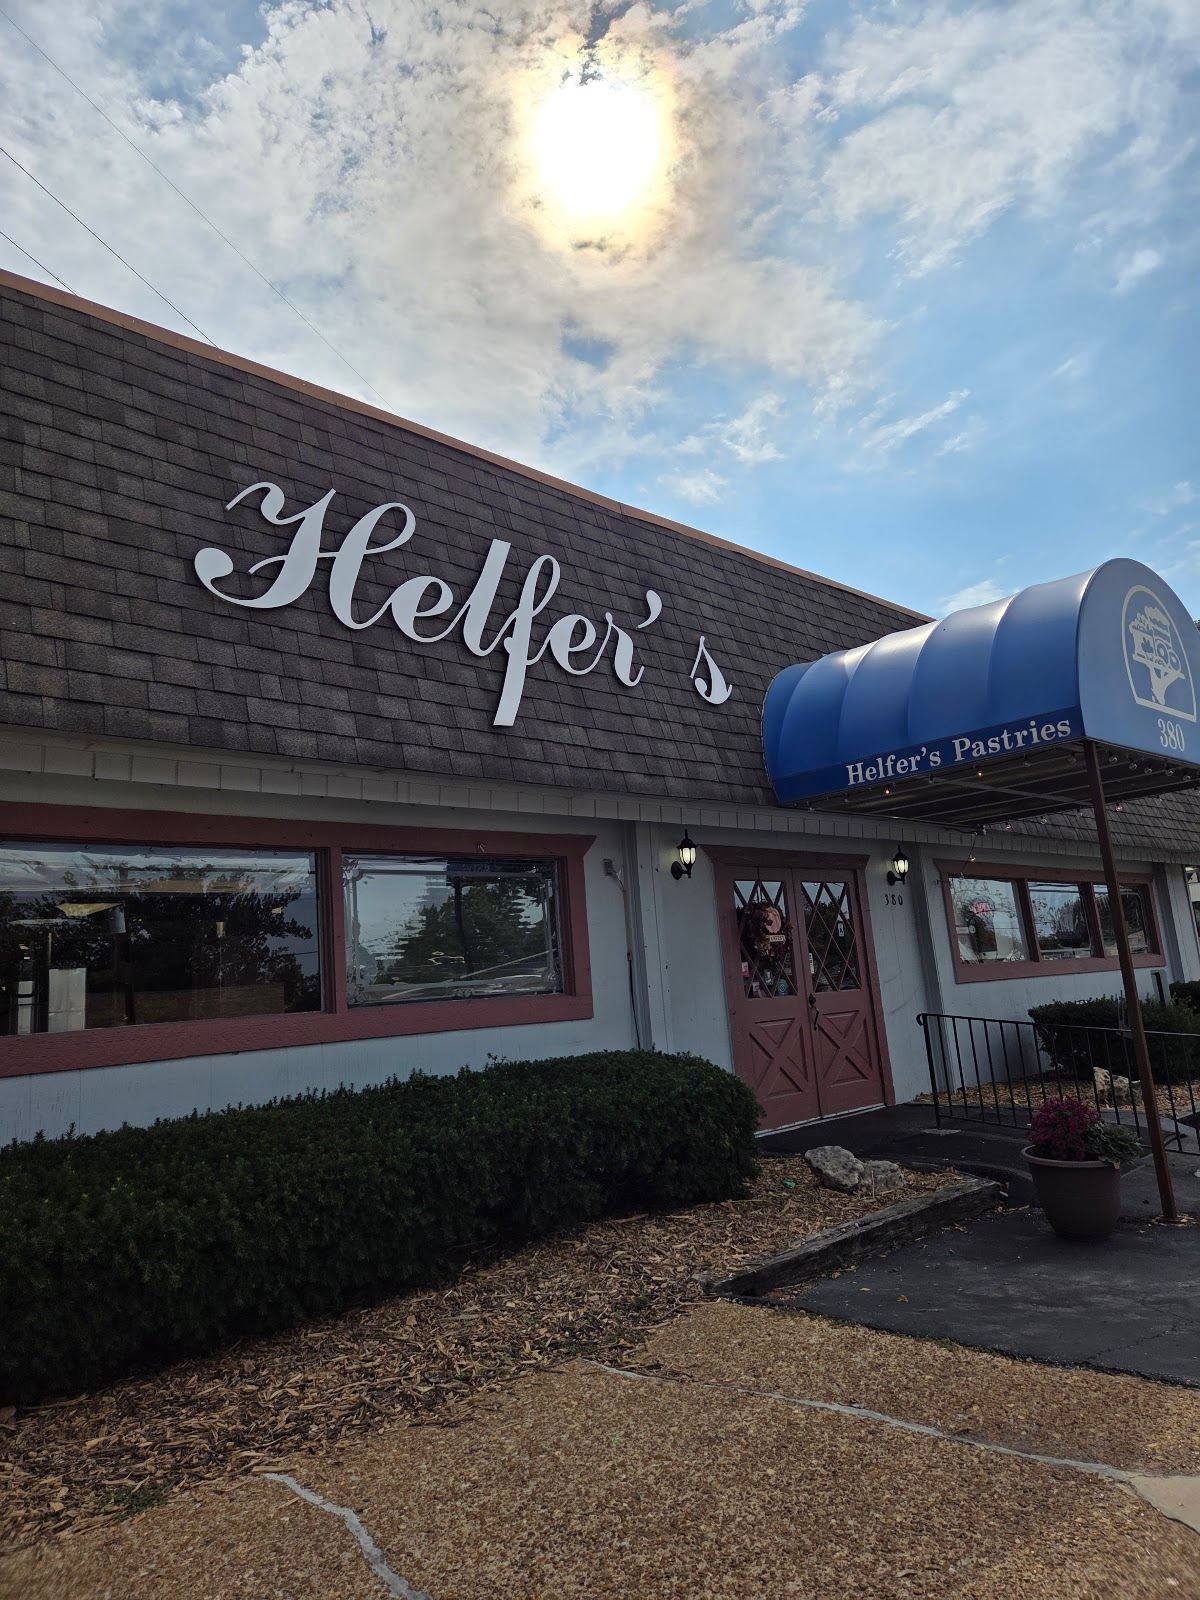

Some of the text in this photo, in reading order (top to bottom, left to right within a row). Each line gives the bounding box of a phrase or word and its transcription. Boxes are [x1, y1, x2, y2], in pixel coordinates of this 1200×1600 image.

[194, 481, 733, 727] Helfer's
[846, 718, 1072, 786] Helfer's Pastries
[1157, 718, 1185, 752] 380
[884, 893, 904, 906] 380
